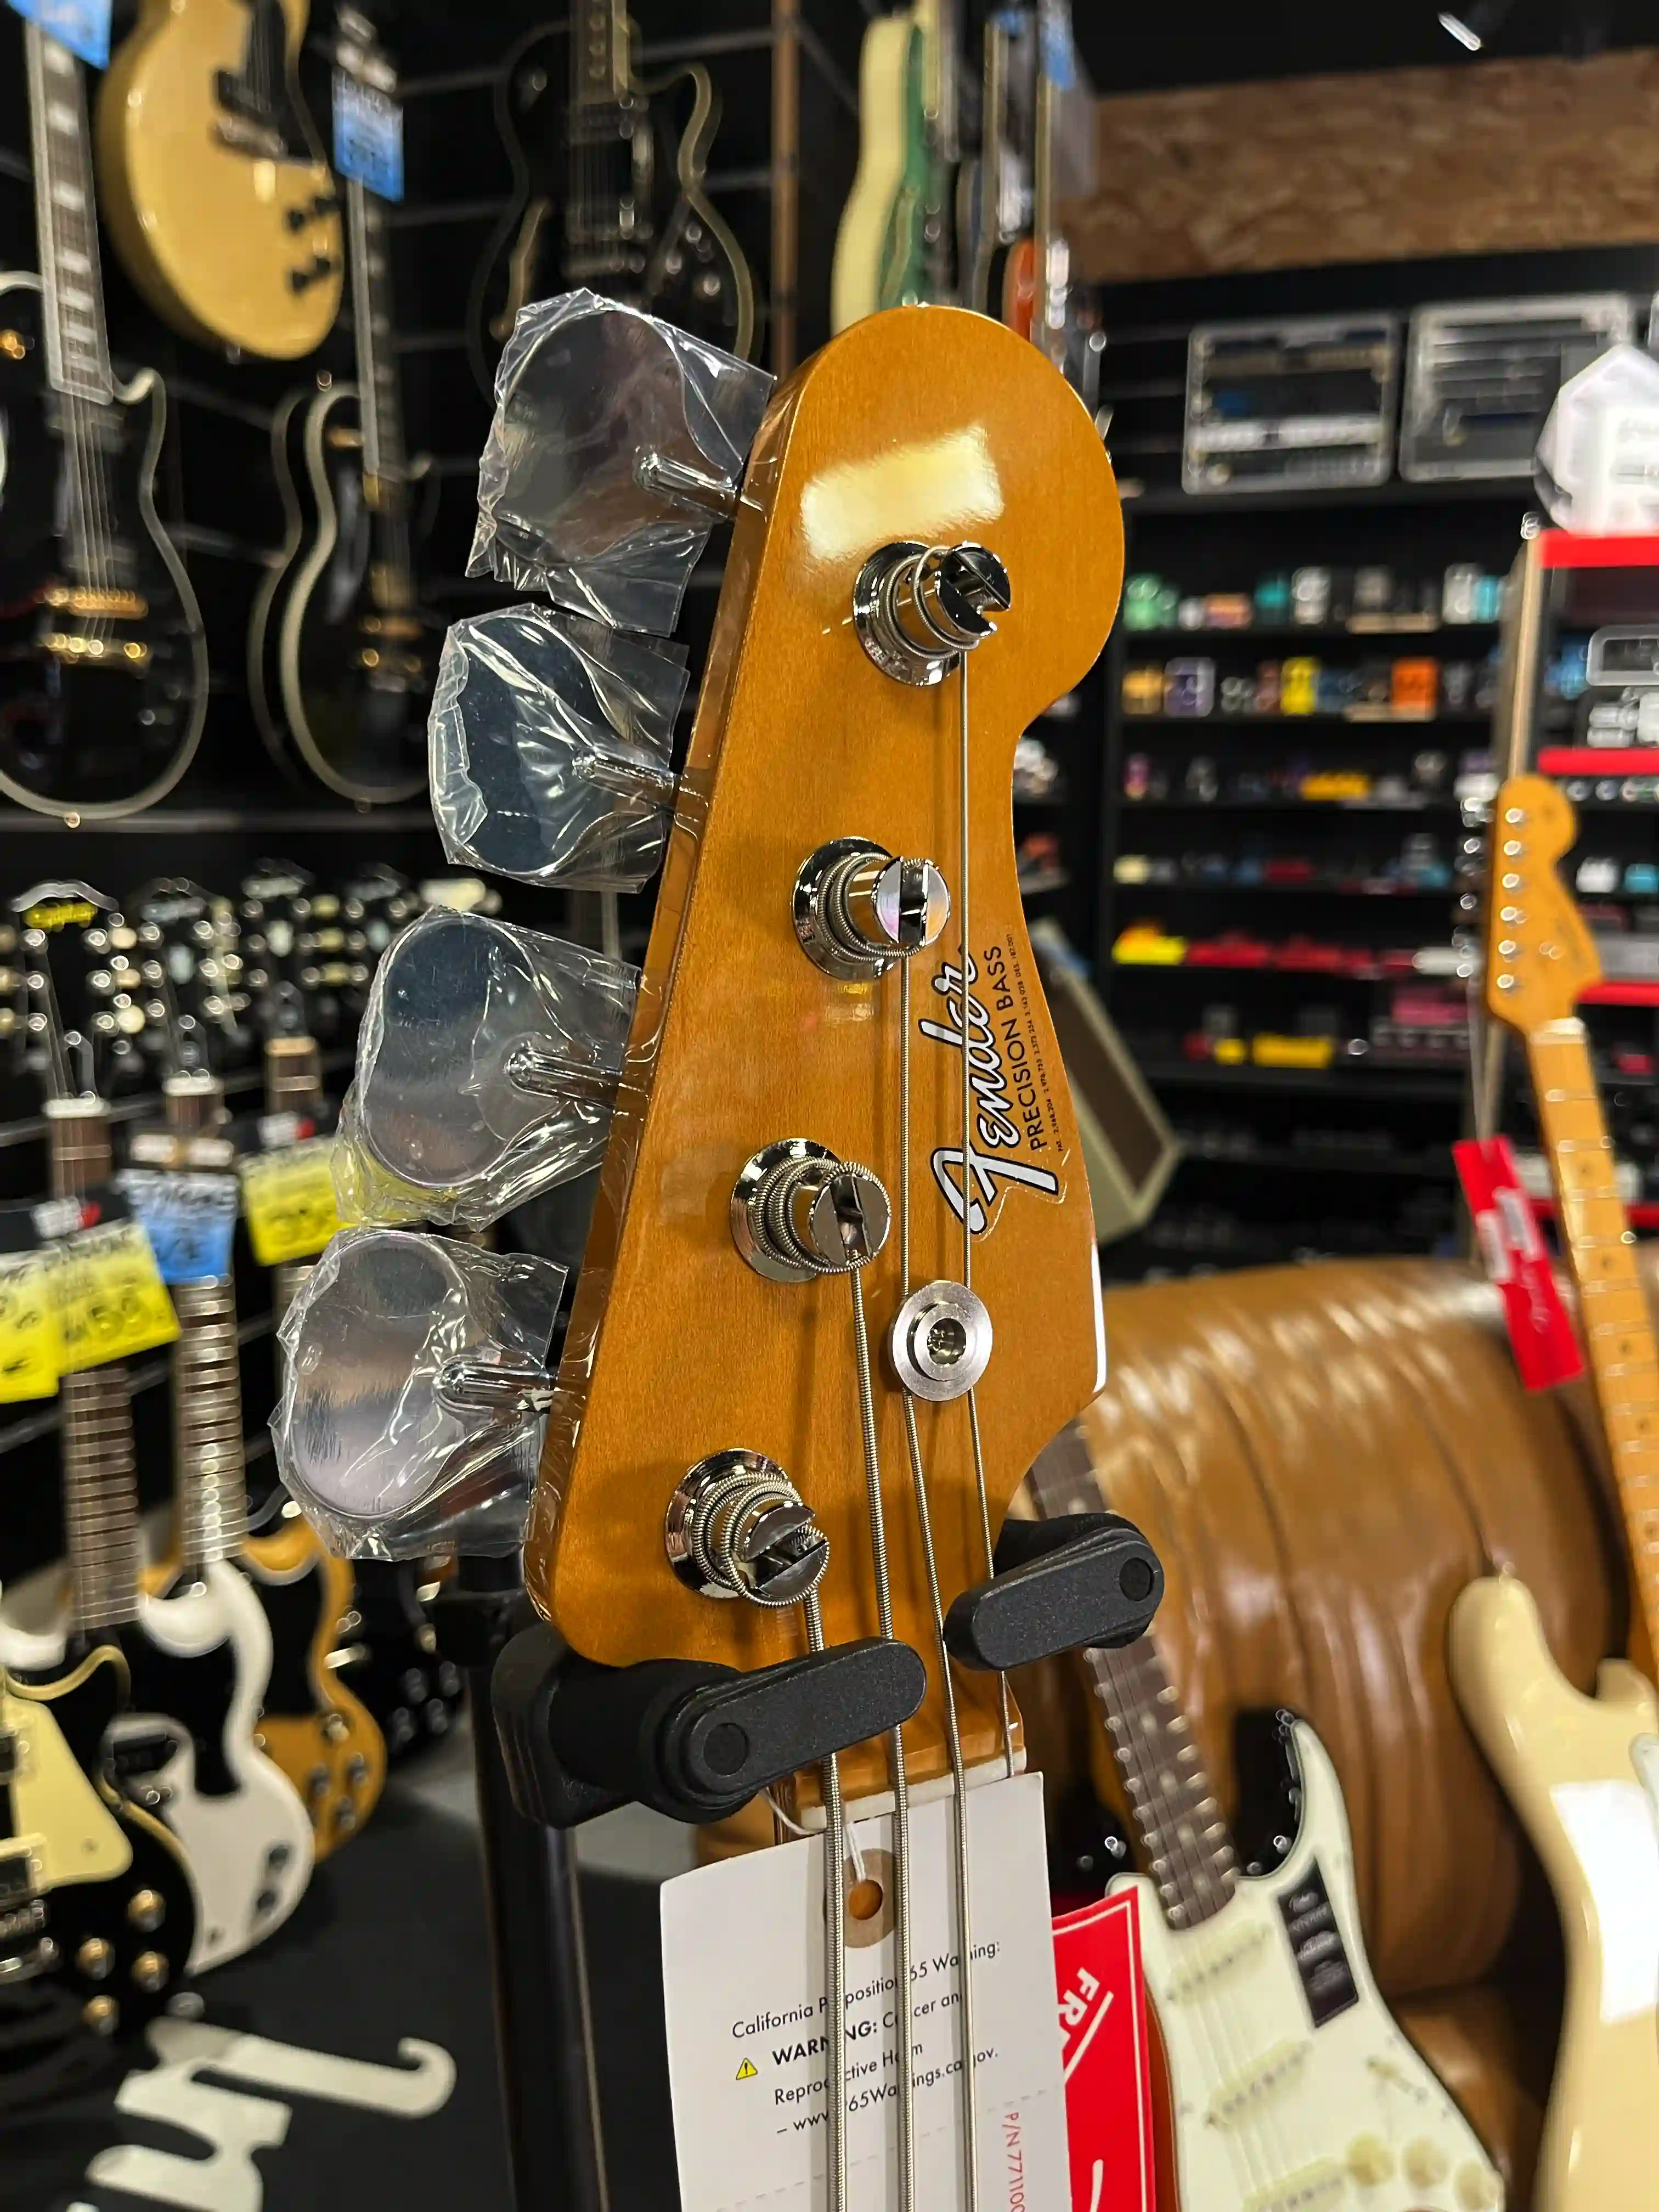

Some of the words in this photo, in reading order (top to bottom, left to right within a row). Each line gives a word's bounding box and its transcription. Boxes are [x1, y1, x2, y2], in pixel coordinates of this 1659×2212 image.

[984, 946, 1014, 1012] BASS
[918, 944, 1059, 1234] Fender
[1001, 1018, 1048, 1151] PRECISION
[732, 2004, 813, 2038] California
[819, 1977, 898, 2013] Ppositio
[910, 1961, 928, 1982] 65
[932, 1942, 1000, 1973] Waing:
[772, 2020, 877, 2066] WARNNG:
[882, 2000, 936, 2028] Ccer
[941, 1992, 962, 2008] an
[1002, 2112, 1021, 2147] P/N
